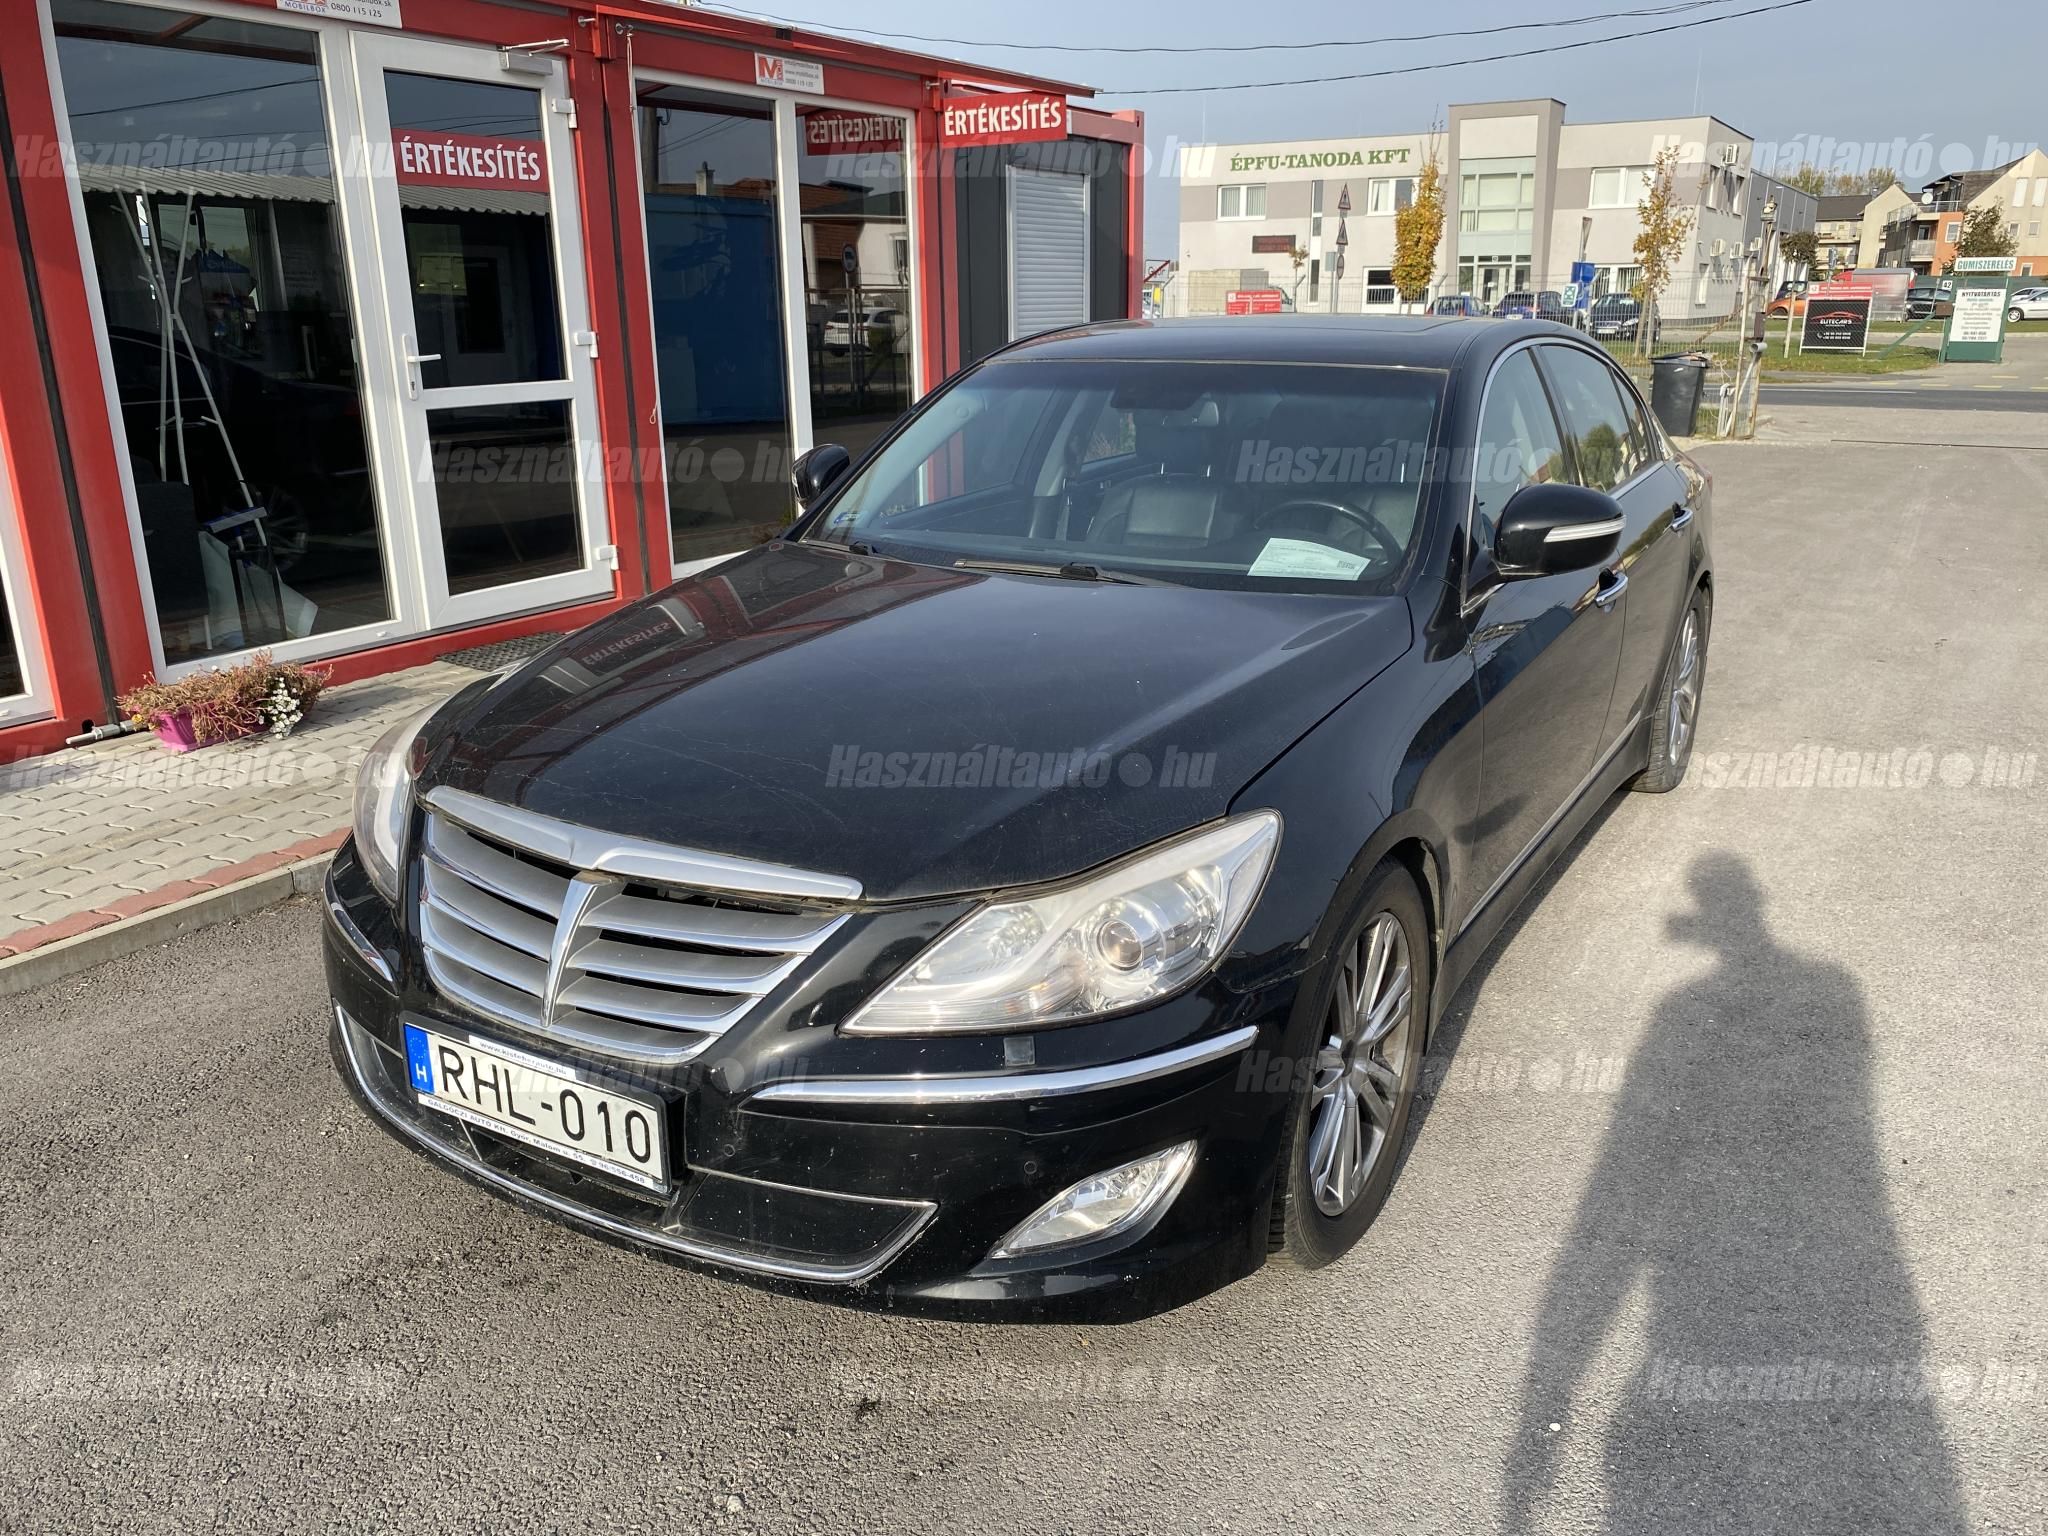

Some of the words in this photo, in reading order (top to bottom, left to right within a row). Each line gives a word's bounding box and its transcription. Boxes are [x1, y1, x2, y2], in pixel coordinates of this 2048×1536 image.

[284, 1, 326, 13] MOBILBOX
[330, 2, 351, 13] 0800
[353, 6, 367, 15] 115
[369, 9, 382, 18] 125
[945, 98, 1062, 136] ÉRTÉKESÍTÉS
[400, 135, 541, 181] ÉRTÉKESÍTÉS
[1230, 152, 1364, 171] ÉPFU-TANODA
[1367, 148, 1411, 165] KFT
[415, 1062, 428, 1083] H
[438, 1045, 651, 1164] RHL-010
